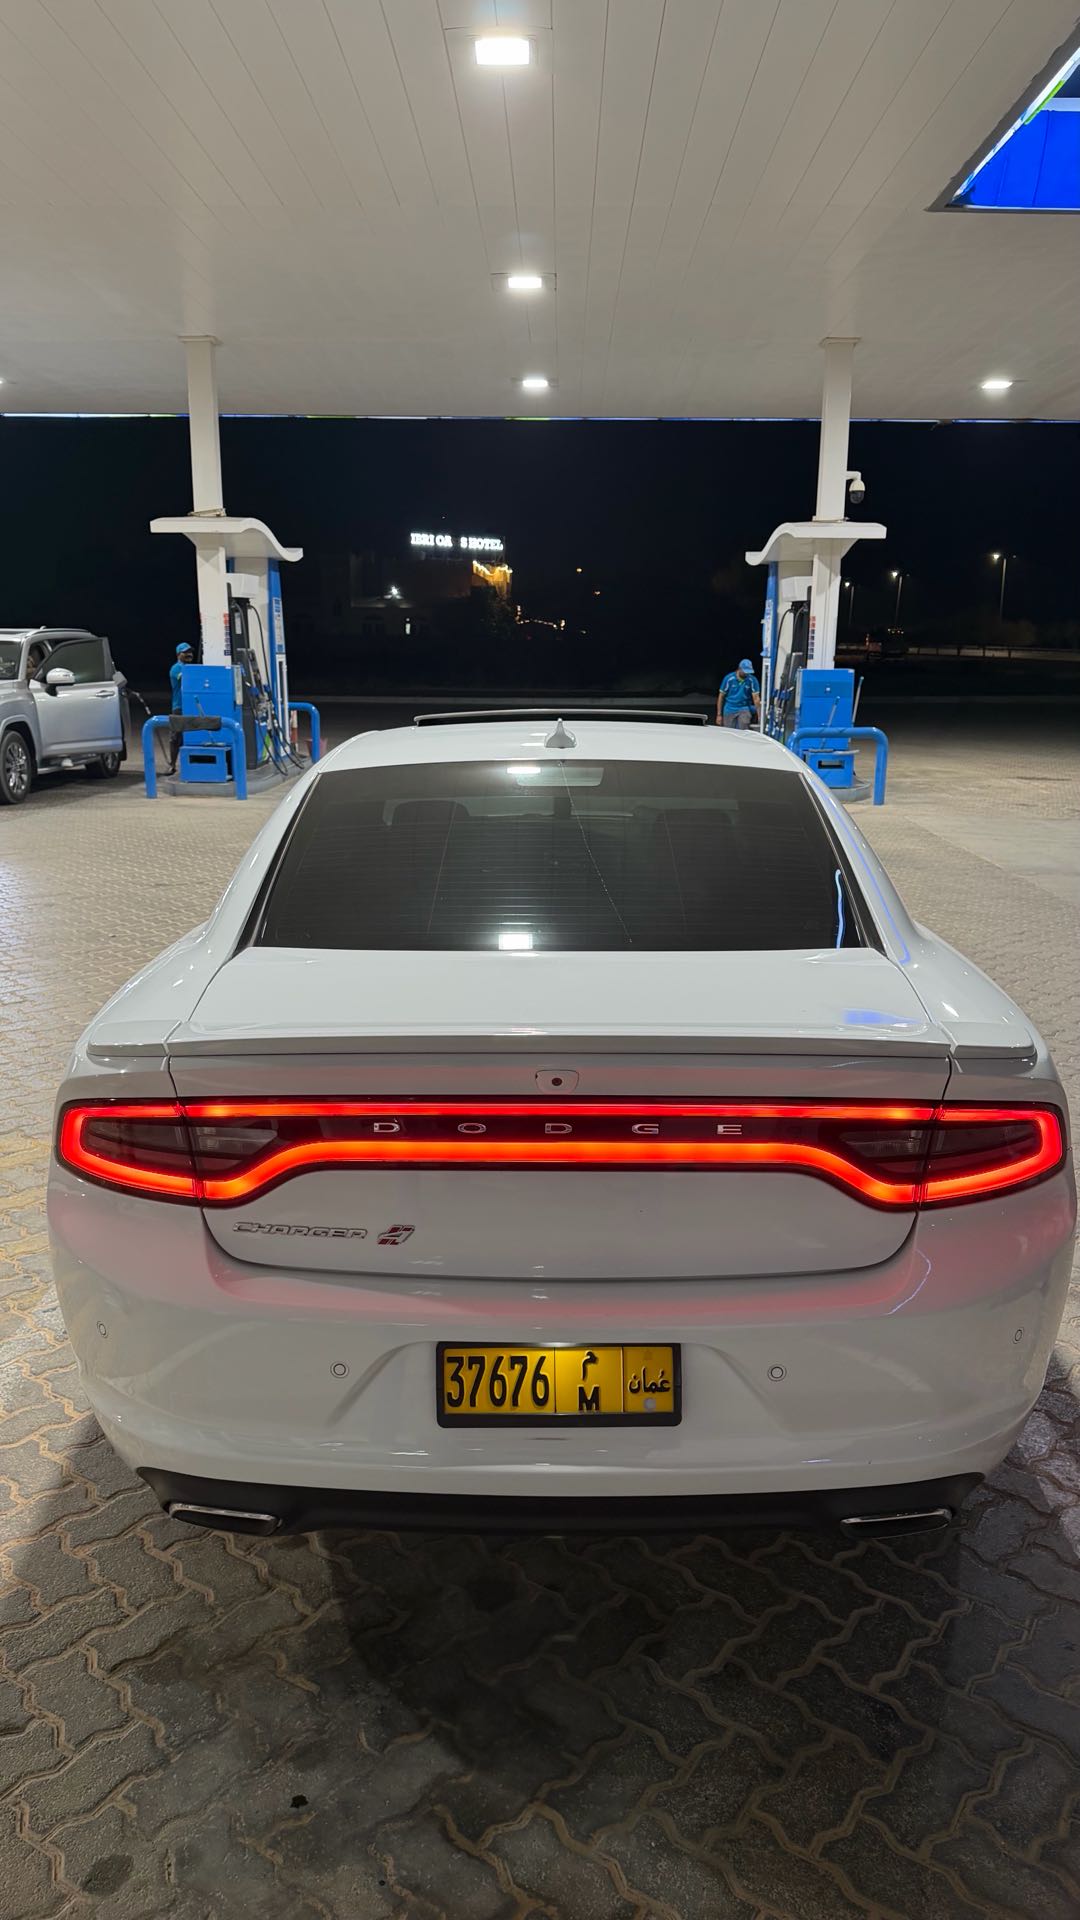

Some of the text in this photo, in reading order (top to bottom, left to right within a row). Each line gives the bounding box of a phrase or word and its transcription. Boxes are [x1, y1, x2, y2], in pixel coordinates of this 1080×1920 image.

[468, 536, 504, 551] HOTEL
[373, 1122, 743, 1135] DODGE
[232, 1221, 369, 1240] CHARGER
[446, 1355, 550, 1408] 37676
[578, 1386, 600, 1412] M
